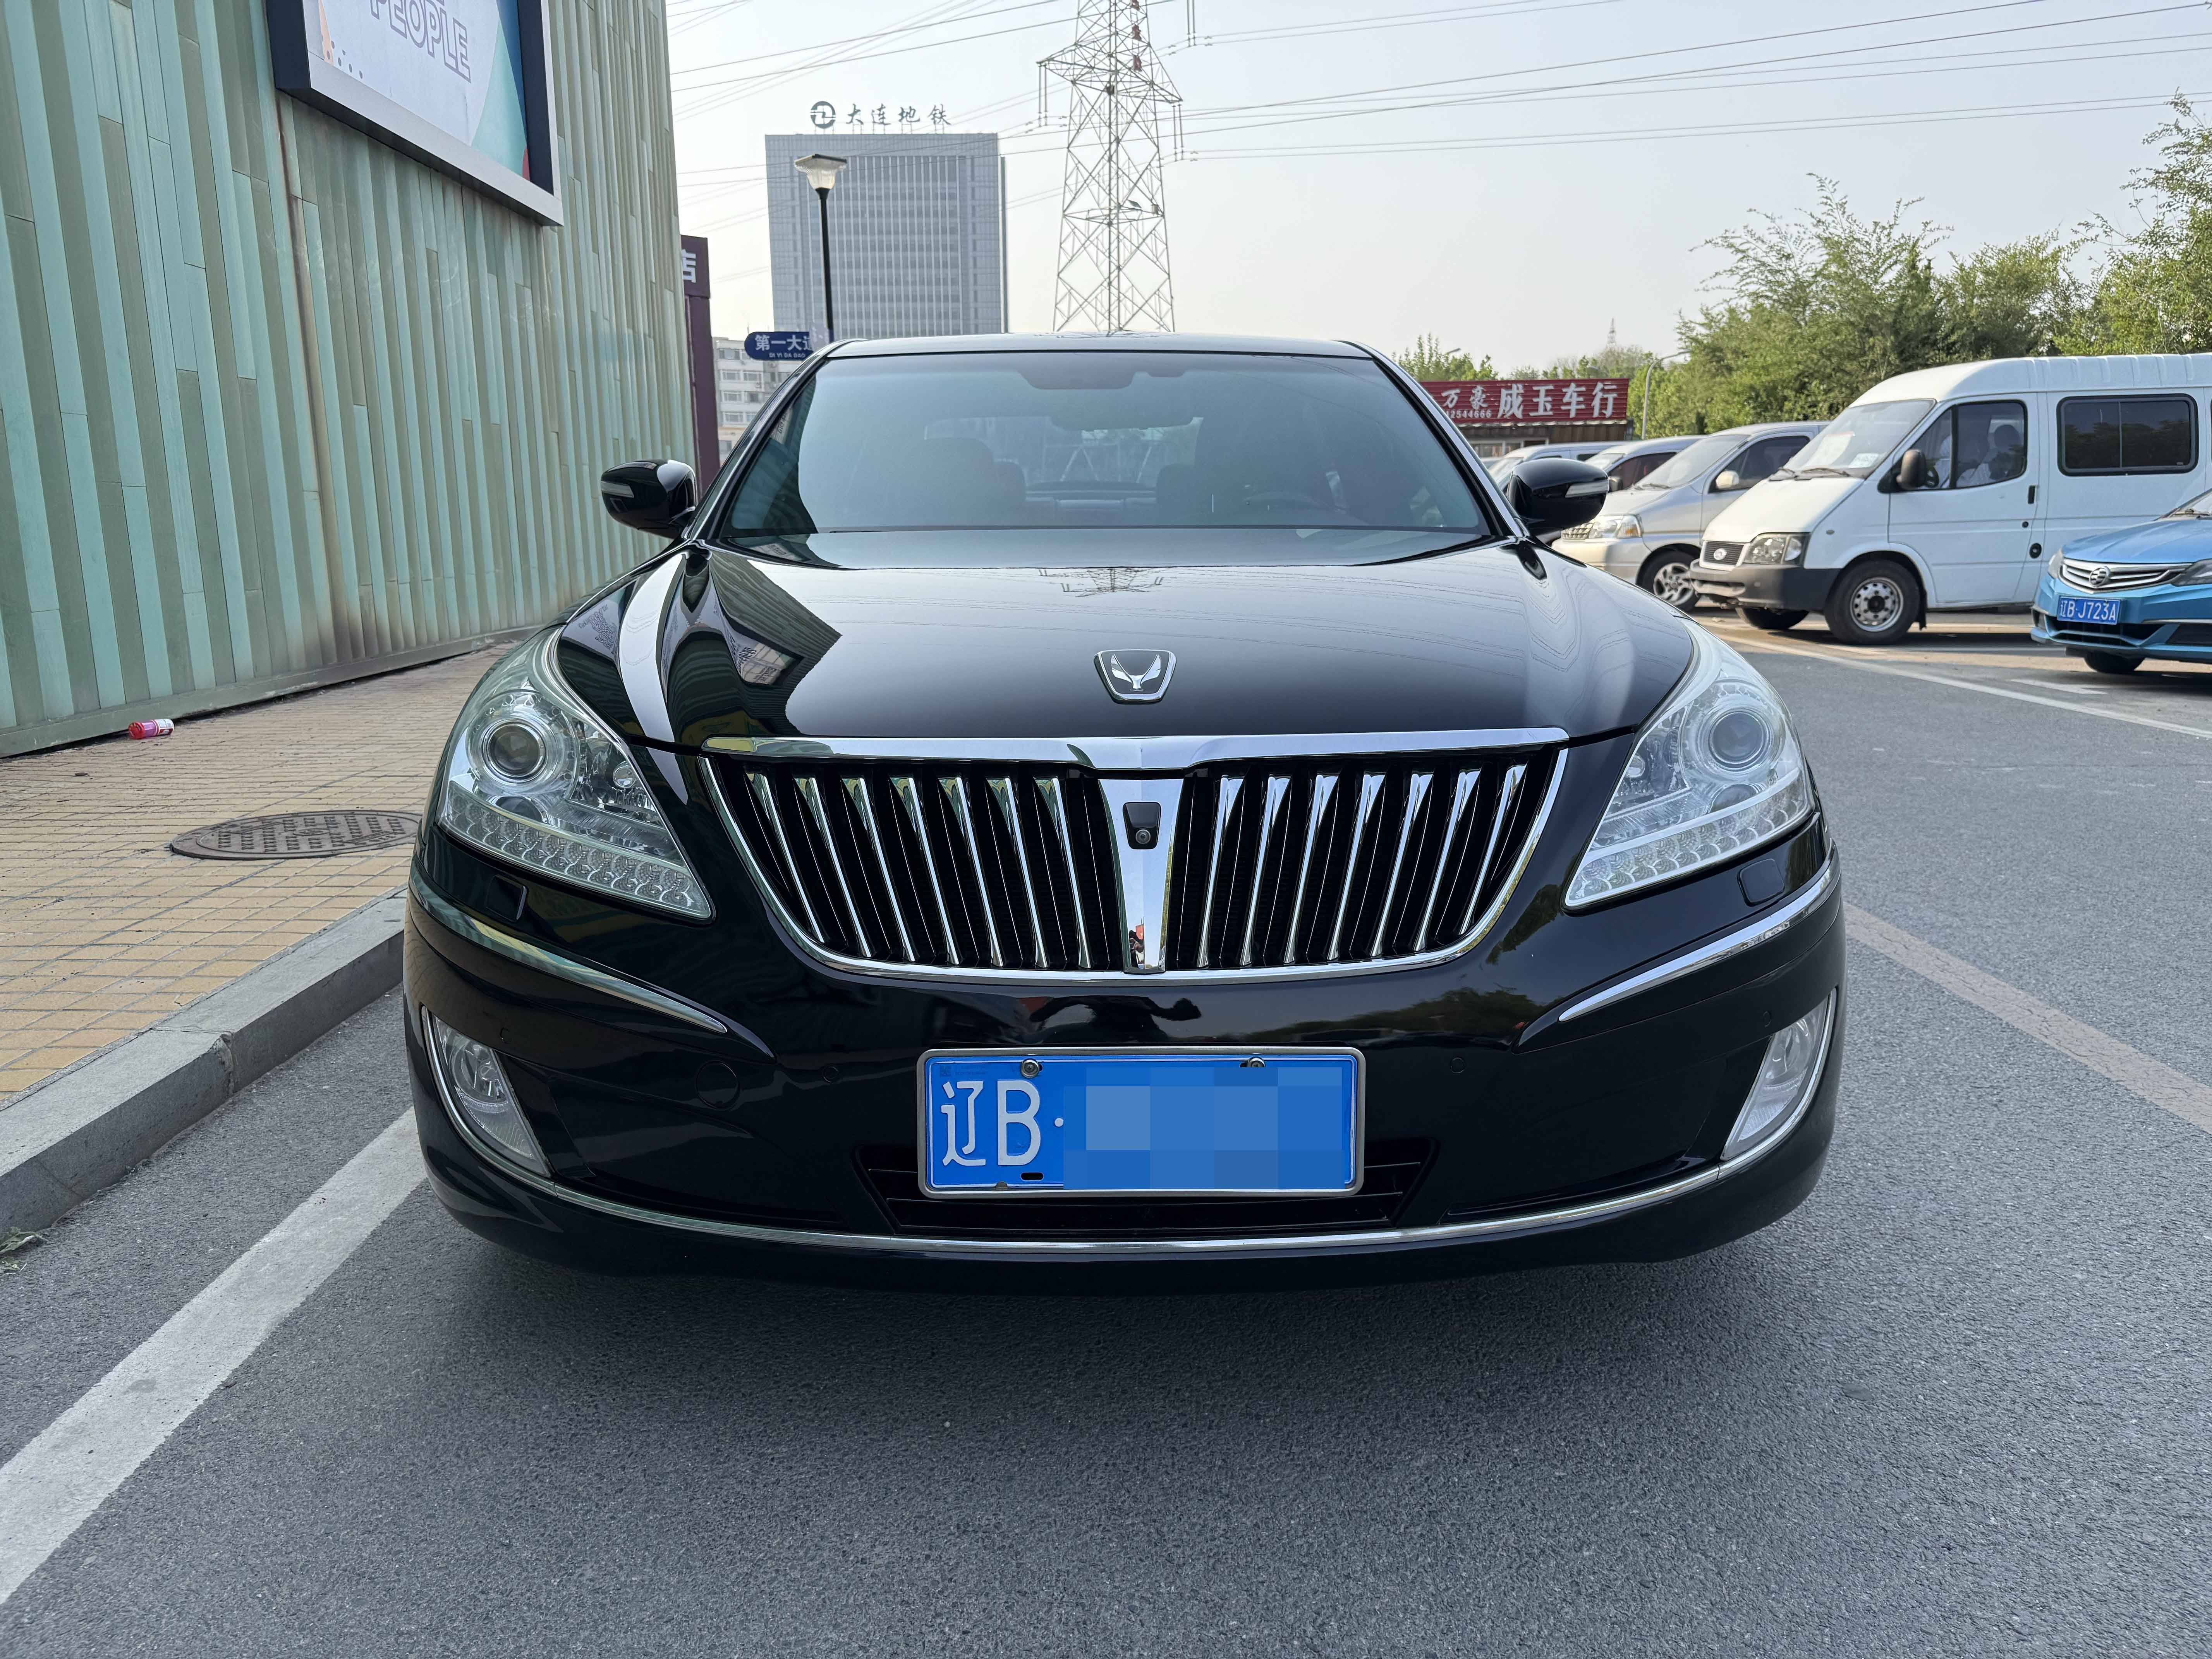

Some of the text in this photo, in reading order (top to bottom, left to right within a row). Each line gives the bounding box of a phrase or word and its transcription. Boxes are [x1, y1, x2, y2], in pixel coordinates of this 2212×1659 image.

[845, 103, 951, 125] 大连地铁
[1441, 382, 1618, 419] 万豪 成玉车行
